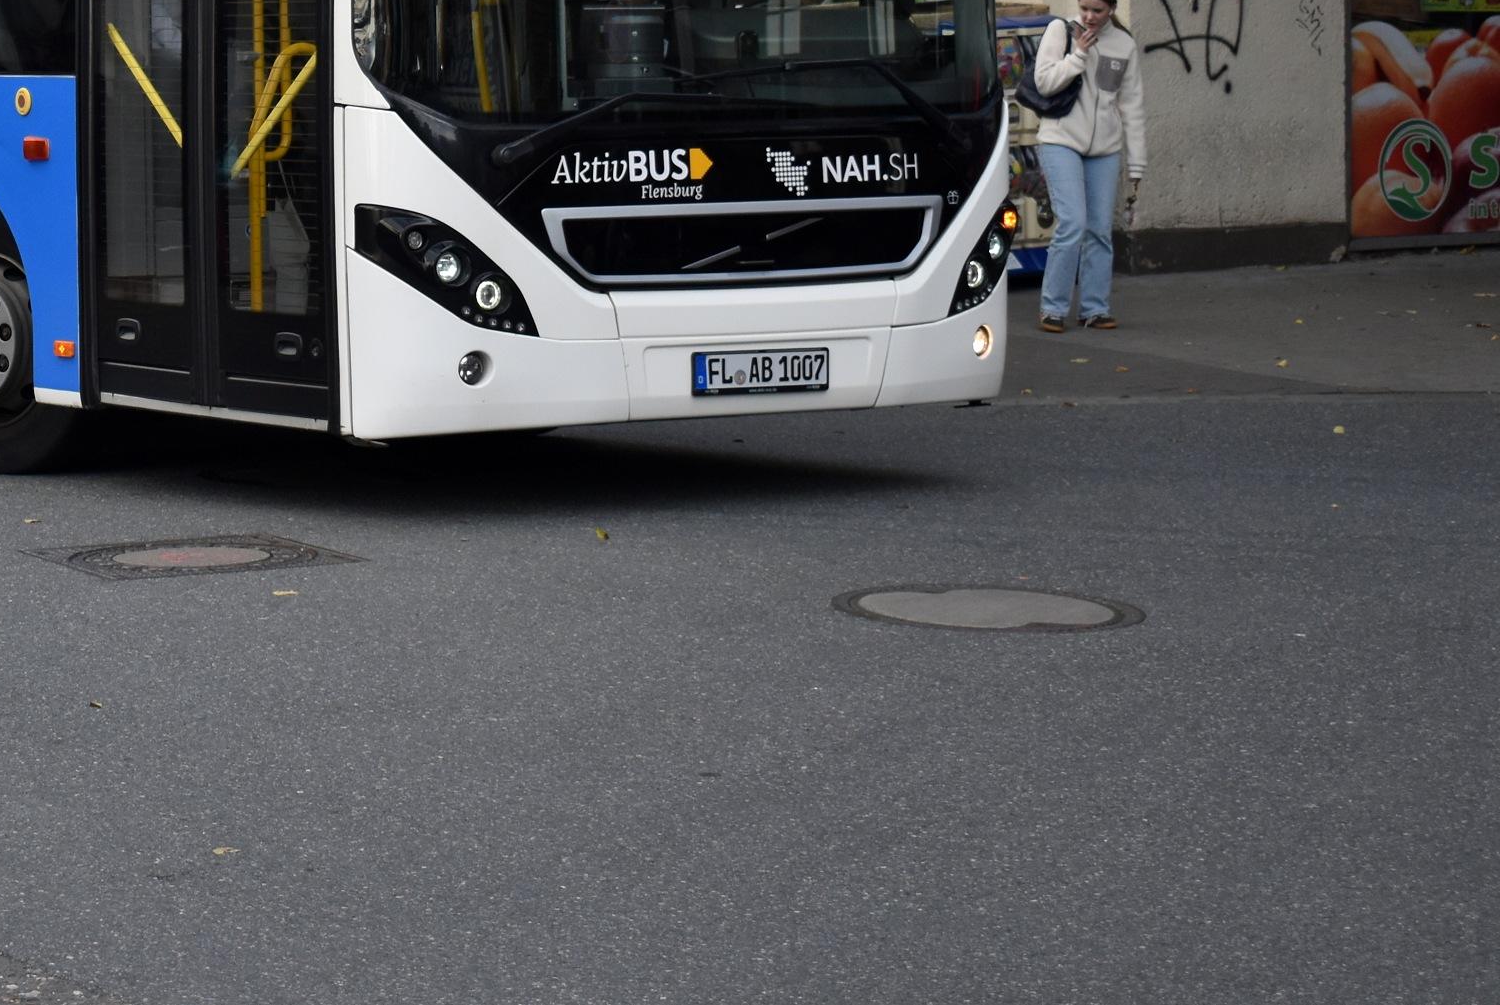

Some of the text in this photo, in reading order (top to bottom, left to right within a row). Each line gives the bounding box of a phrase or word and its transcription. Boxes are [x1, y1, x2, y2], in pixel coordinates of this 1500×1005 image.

[551, 147, 919, 185] AktivBUS NAH.SH
[641, 183, 703, 200] Flensburg
[708, 358, 733, 385] FL
[749, 356, 773, 383] AB
[779, 354, 825, 382] 1007
